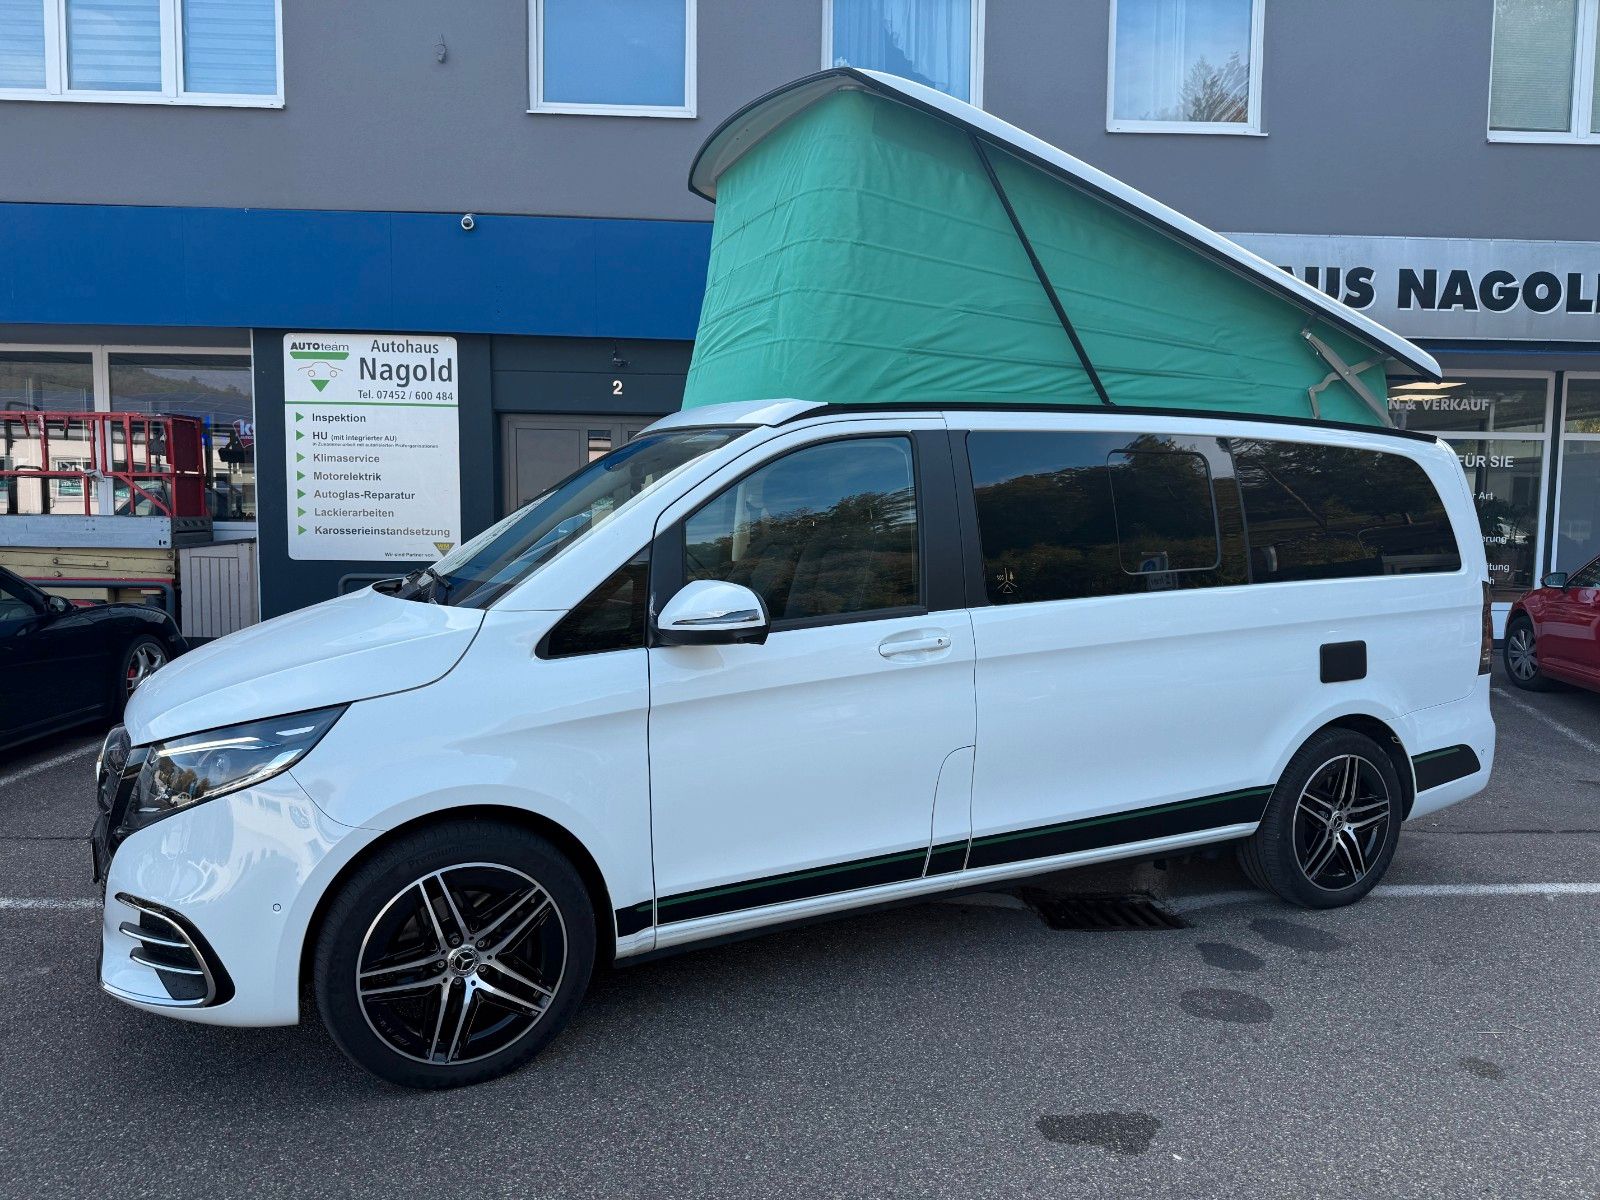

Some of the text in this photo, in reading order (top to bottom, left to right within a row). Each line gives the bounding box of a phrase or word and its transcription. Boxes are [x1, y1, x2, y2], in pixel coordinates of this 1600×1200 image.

[1397, 269, 1600, 314] NAGOL
[371, 339, 439, 354] Autohaus
[360, 358, 452, 387] Nagold
[612, 380, 623, 395] 2
[358, 389, 374, 399] Tel.
[376, 390, 406, 400] 07452
[415, 391, 433, 400] 600
[435, 391, 453, 401] 484
[1405, 398, 1416, 411] &
[1423, 398, 1489, 411] VERKAUF
[312, 412, 367, 424] Inspektion
[312, 431, 328, 440] HU
[345, 434, 383, 443] integrierter
[313, 453, 380, 463] Klimaservice
[1490, 455, 1514, 468] SIE
[313, 472, 381, 481] Motorelektrik
[314, 489, 415, 501] Autoglas-Reparatur
[1478, 492, 1493, 500] Art
[314, 507, 395, 517] Lackierarbeiten
[315, 526, 450, 537] Karosserieinstandsetzung
